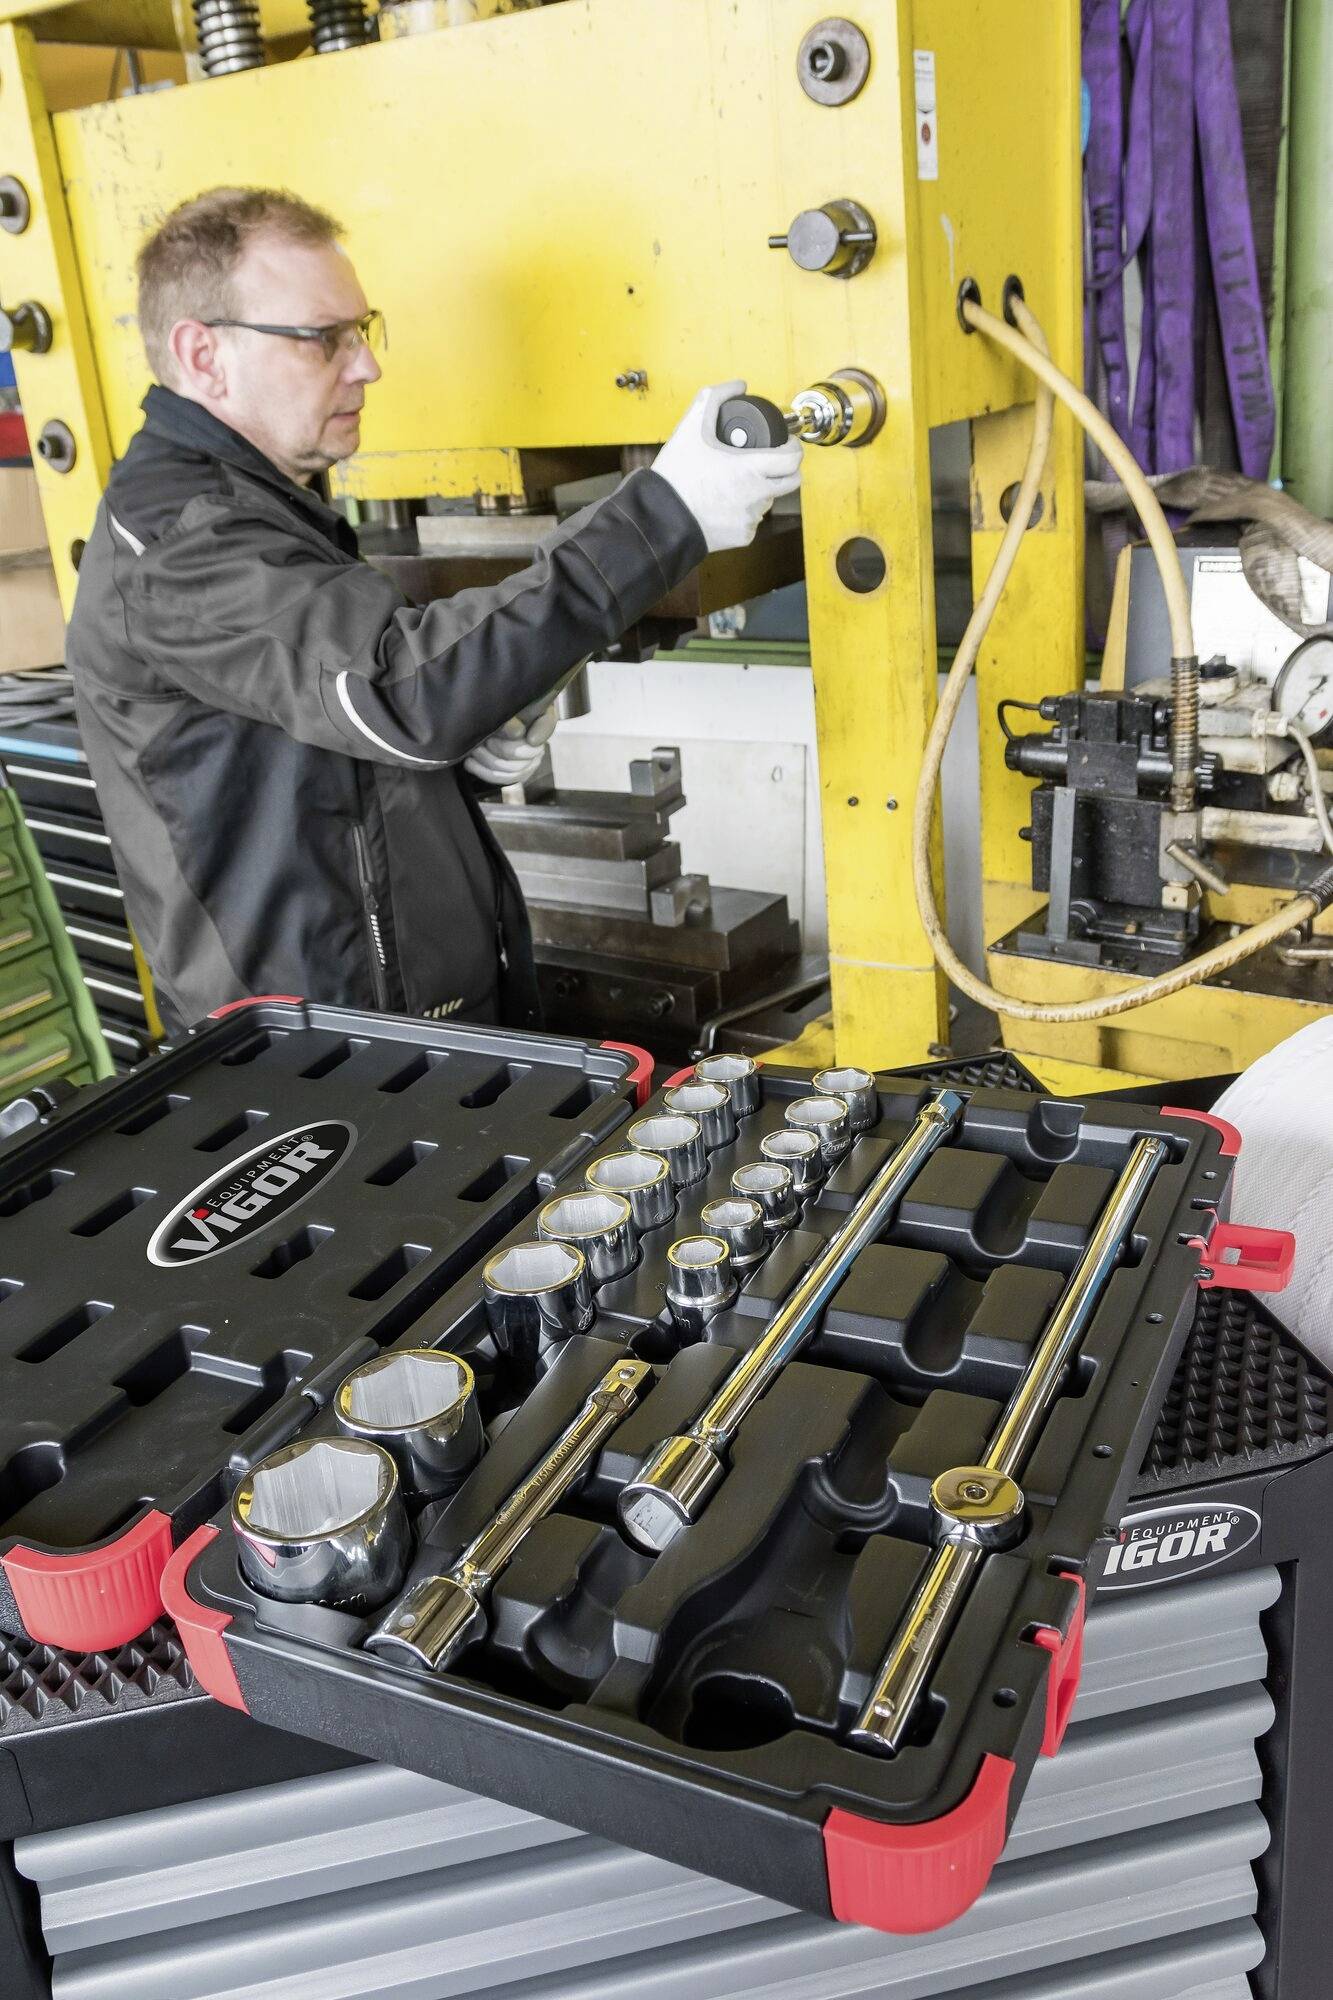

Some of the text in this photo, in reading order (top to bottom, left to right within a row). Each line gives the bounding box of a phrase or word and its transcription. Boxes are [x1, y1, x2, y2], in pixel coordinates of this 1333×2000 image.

[170, 1141, 336, 1252] VIGOR
[207, 1135, 302, 1208] EQUIPMENT
[1102, 1521, 1232, 1576] IGOR
[1130, 1510, 1234, 1541] EQUIPMENT
